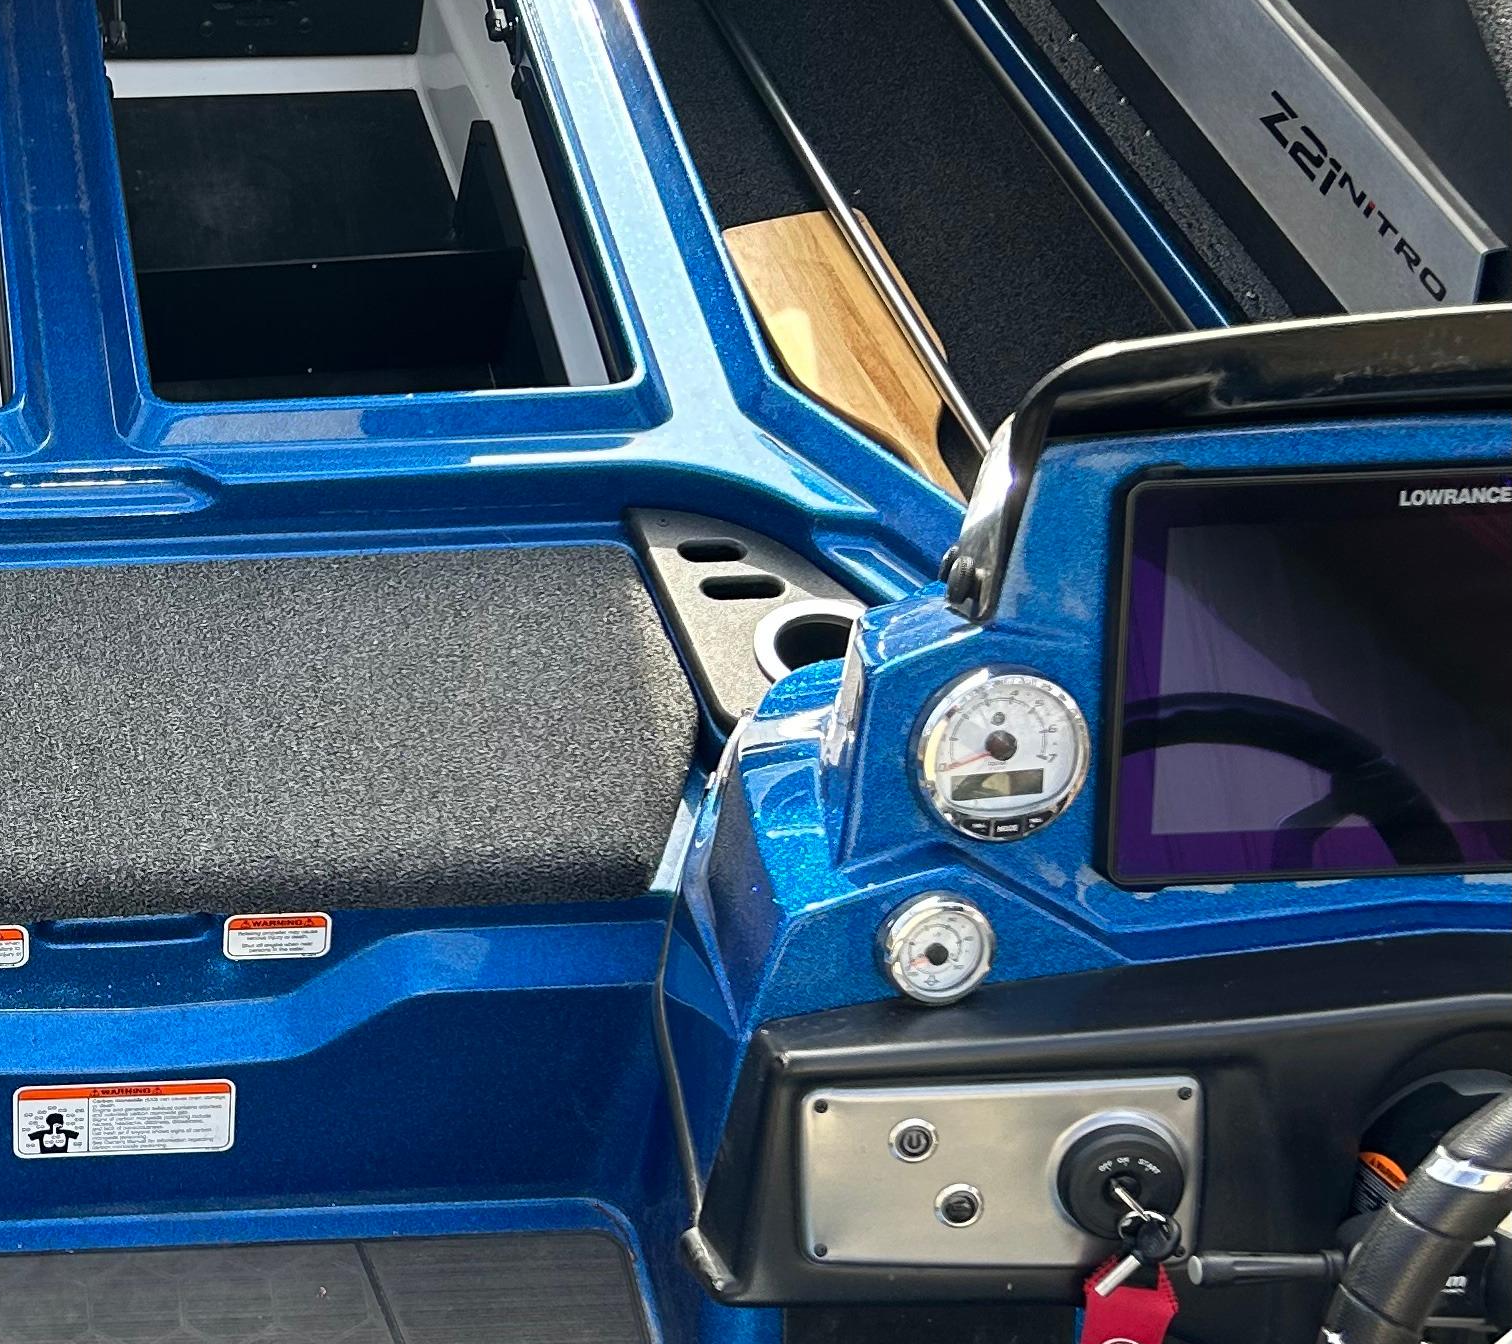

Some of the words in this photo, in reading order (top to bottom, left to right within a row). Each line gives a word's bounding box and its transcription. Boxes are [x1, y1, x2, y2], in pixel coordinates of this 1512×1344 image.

[1259, 89, 1343, 196] Z21
[1337, 170, 1447, 302] NITRO
[1399, 486, 1512, 507] LOWRANCE
[251, 919, 303, 928] WARNING
